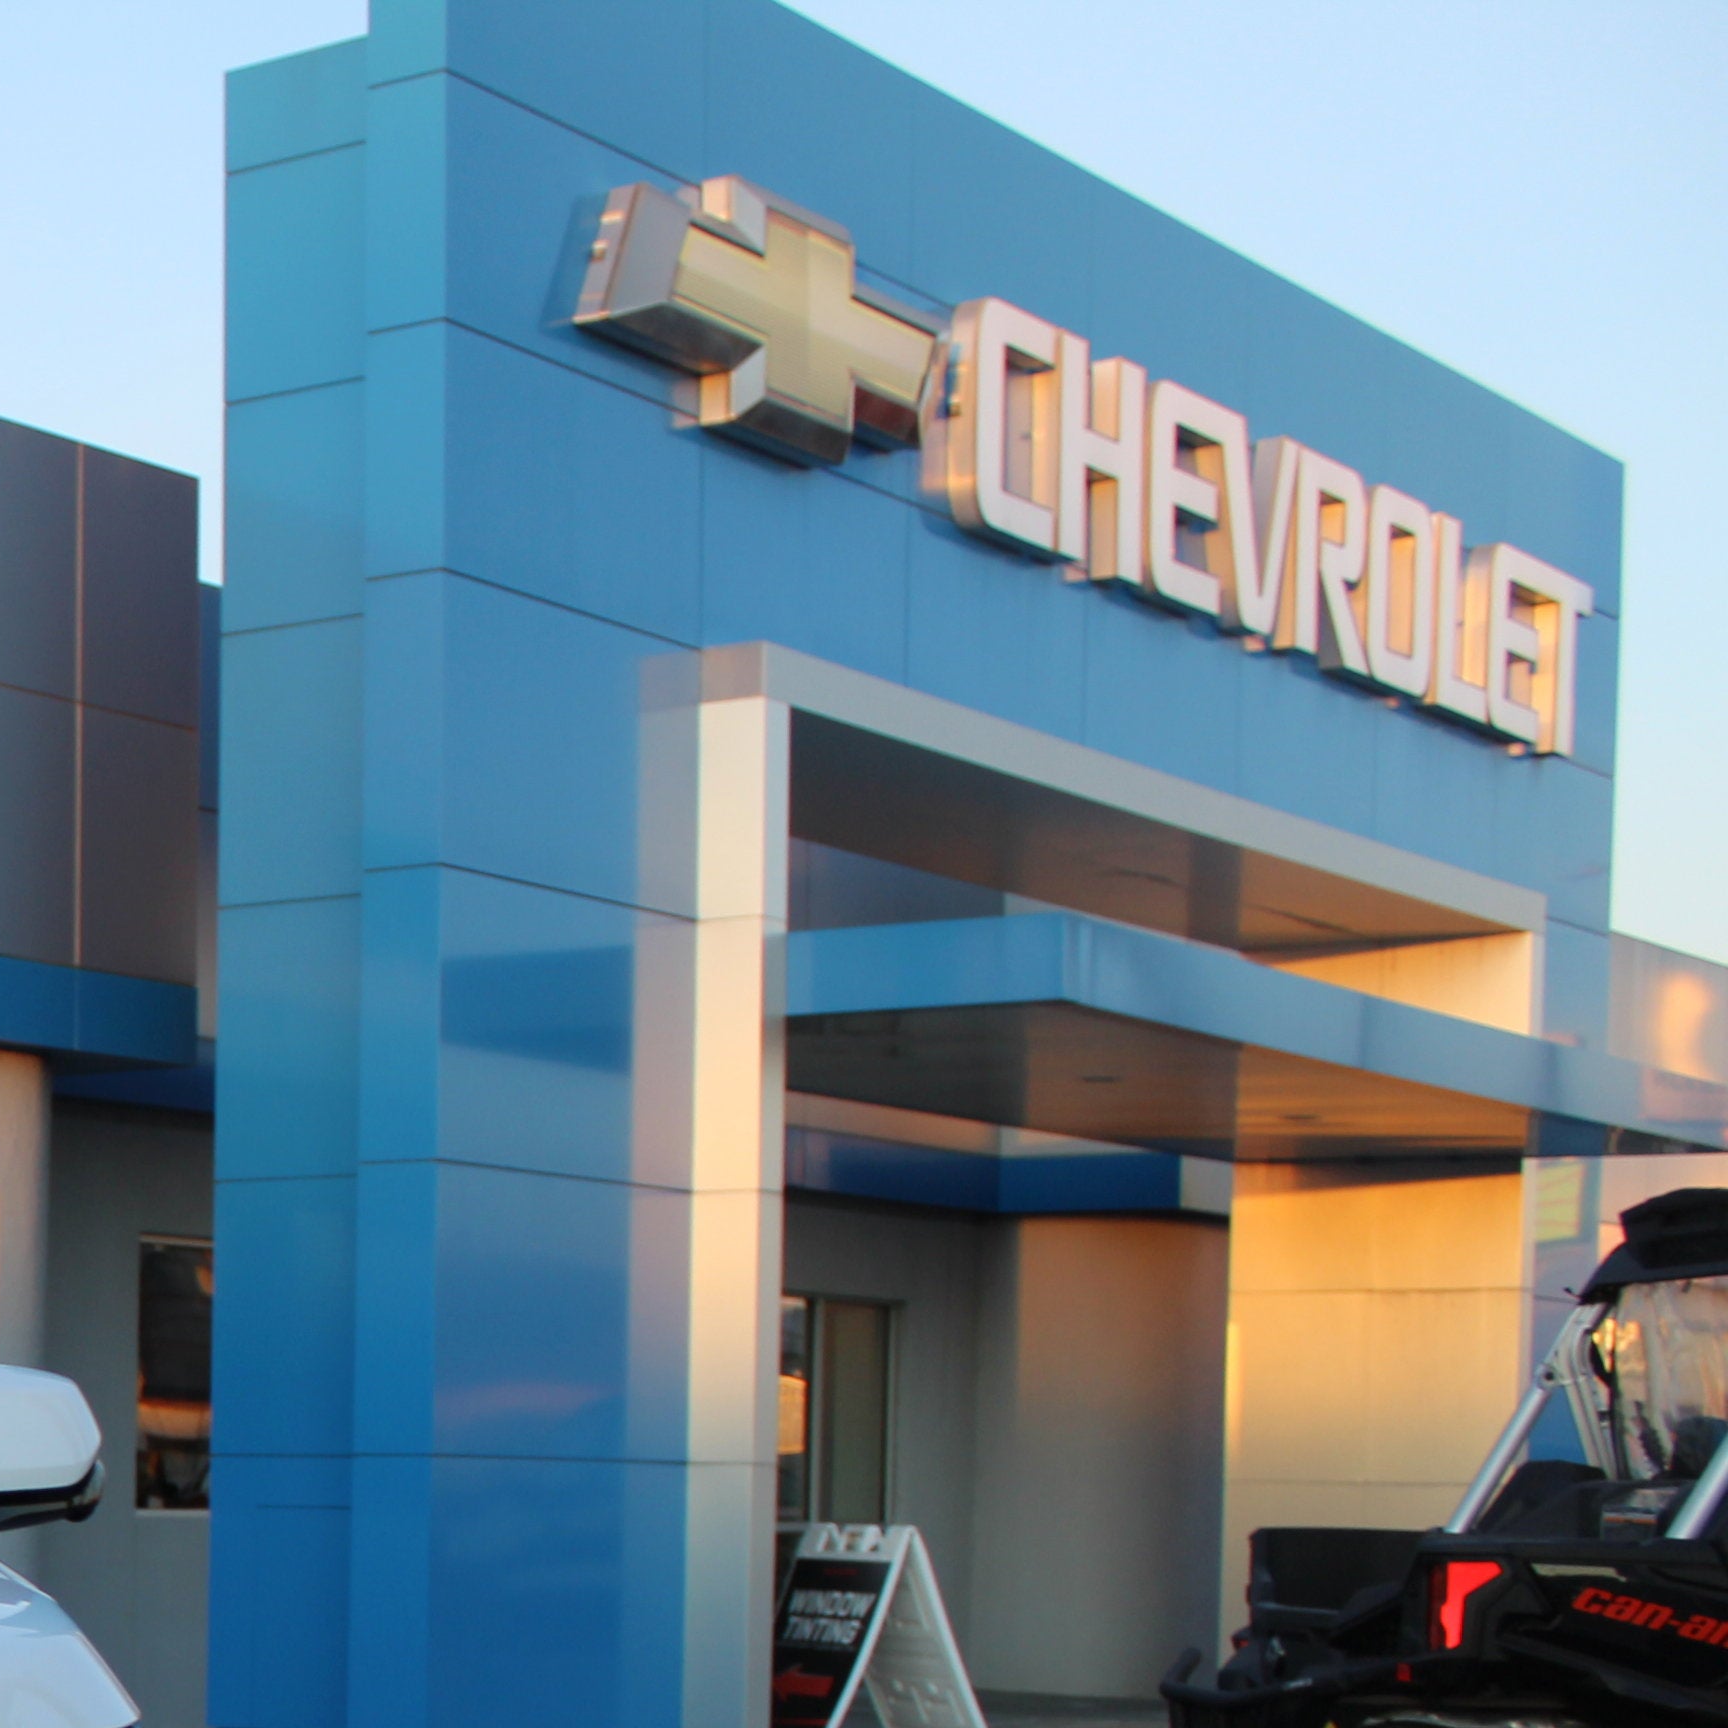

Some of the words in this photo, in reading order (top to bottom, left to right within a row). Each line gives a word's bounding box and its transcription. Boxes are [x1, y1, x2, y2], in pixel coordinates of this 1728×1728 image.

[948, 296, 1594, 757] CHEVROLET
[789, 1590, 876, 1618] WINDOW
[783, 1616, 861, 1645] TINTING
